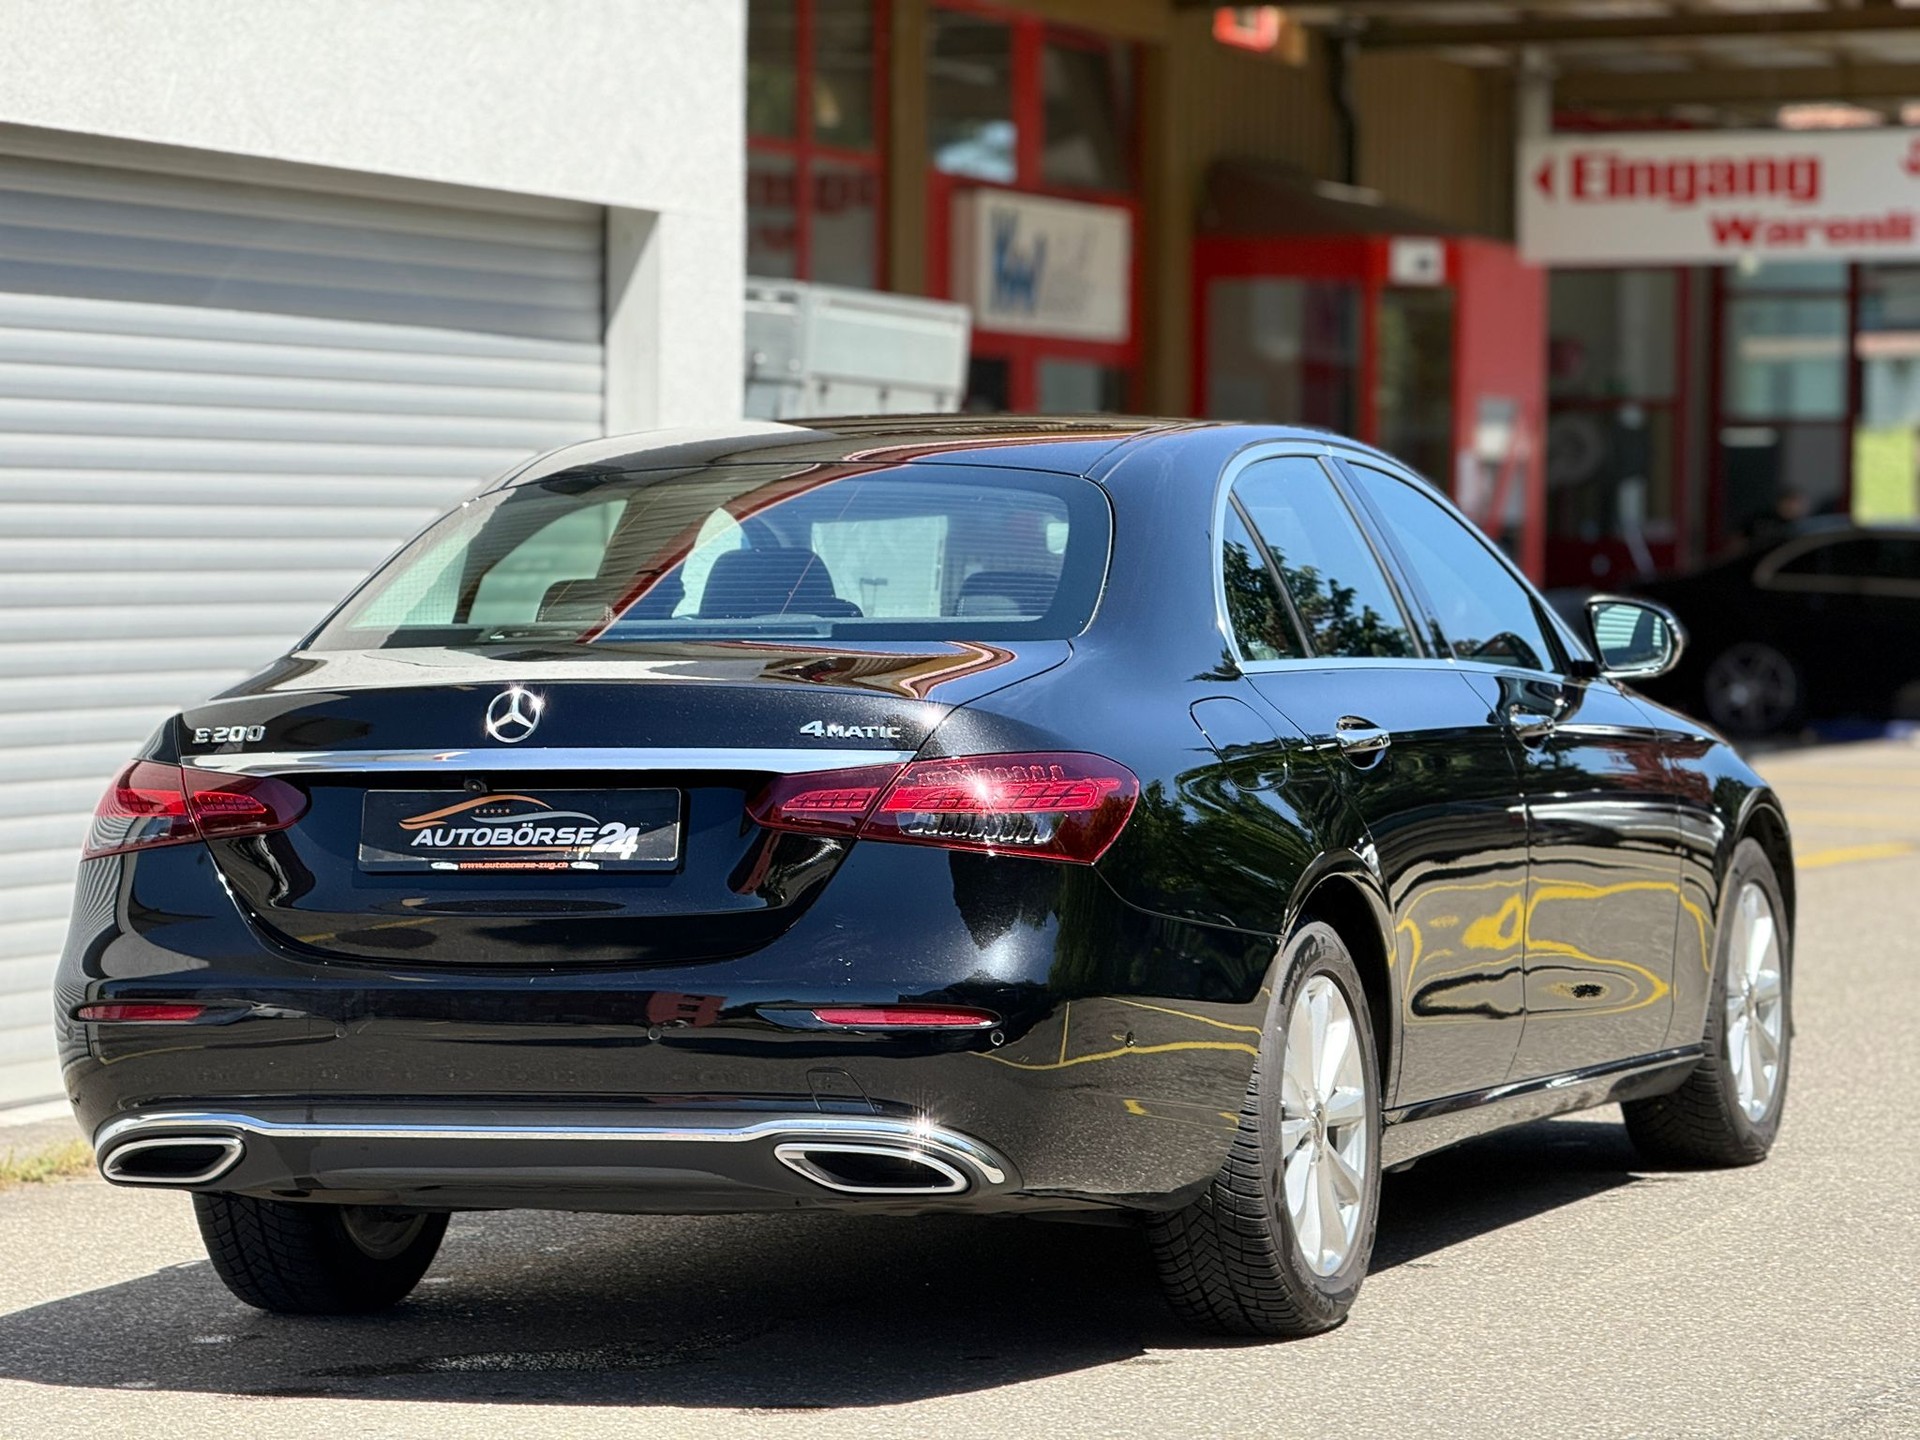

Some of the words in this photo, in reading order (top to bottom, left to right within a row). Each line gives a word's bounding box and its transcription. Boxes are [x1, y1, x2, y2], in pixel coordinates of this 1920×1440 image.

[1569, 151, 1822, 205] Eingang
[800, 720, 901, 738] 4MATIC
[459, 862, 570, 870] www.autoboerse-zug.ch
